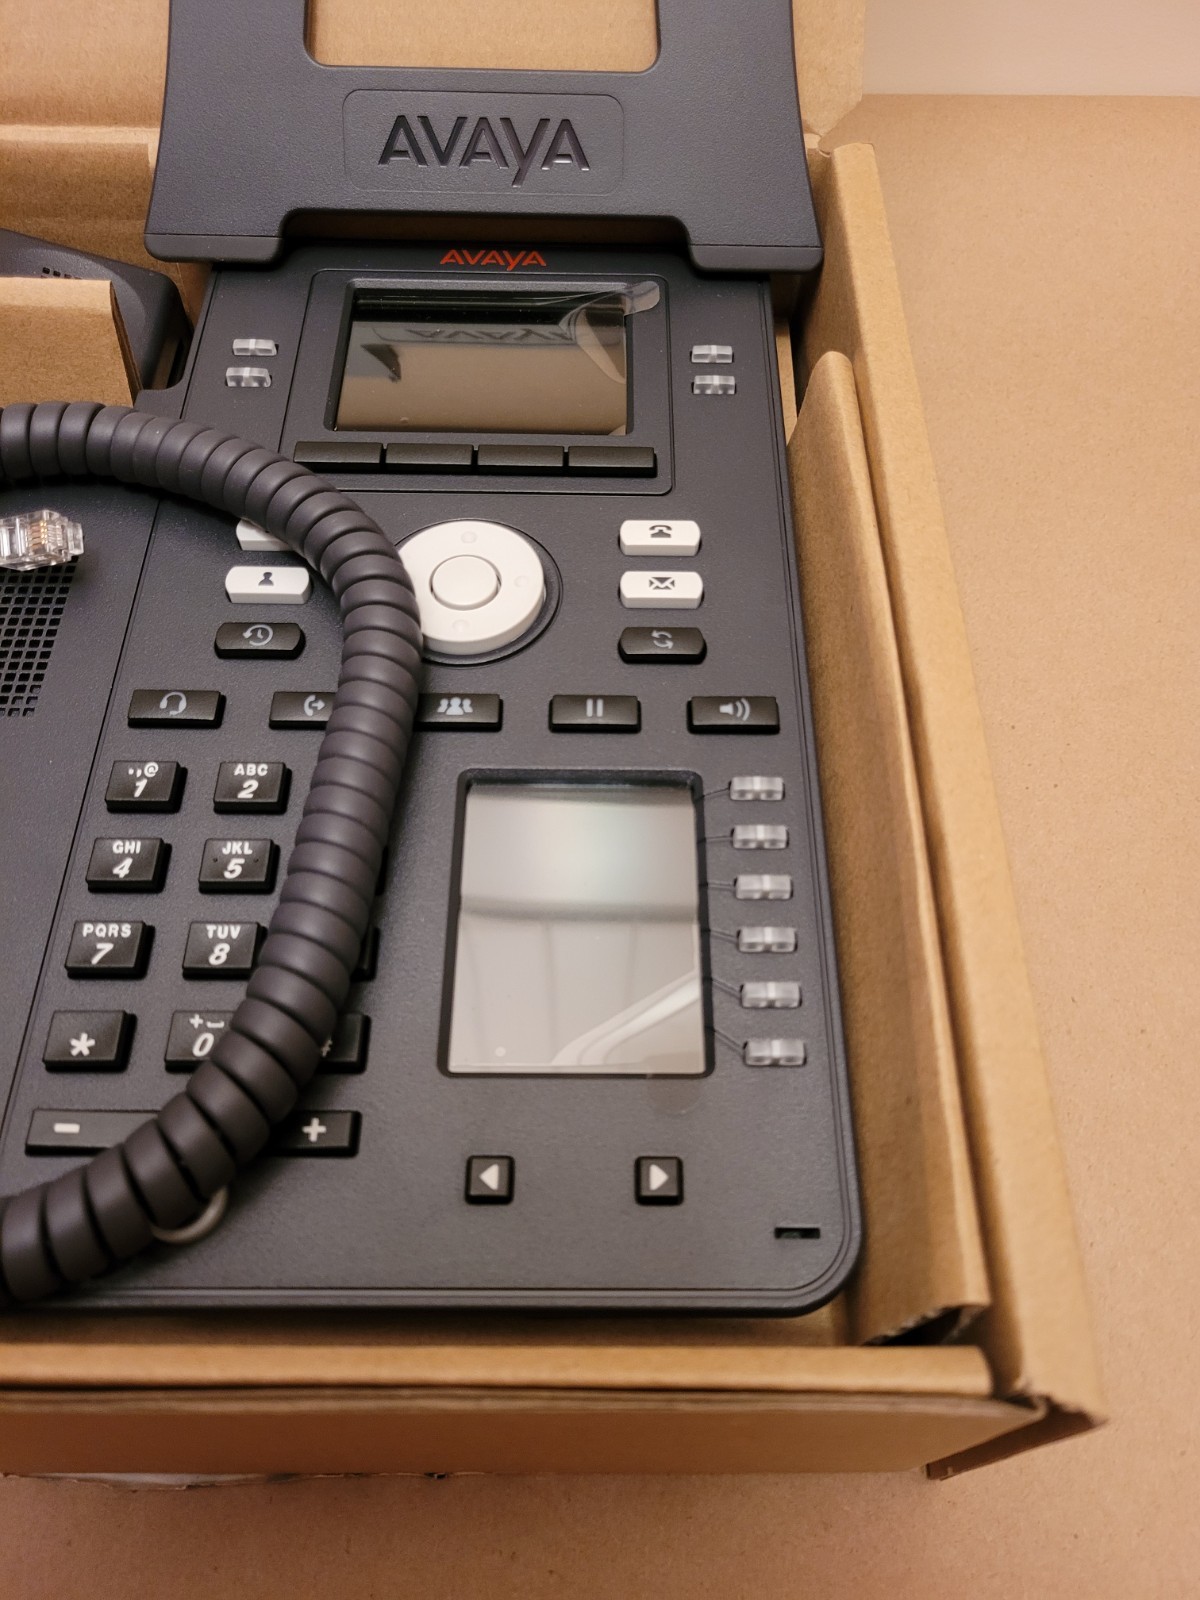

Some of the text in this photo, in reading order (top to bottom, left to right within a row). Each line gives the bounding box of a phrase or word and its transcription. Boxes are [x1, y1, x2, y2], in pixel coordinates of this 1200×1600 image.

[378, 115, 591, 187] AVAYA
[440, 249, 547, 271] AVAYA
[233, 763, 269, 777] ABC
[134, 778, 149, 798] 1
[237, 779, 259, 799] 2
[112, 840, 142, 854] GHI
[221, 841, 254, 855] JKL
[112, 857, 133, 879] 4
[223, 857, 246, 879] 5
[82, 923, 132, 938] PQRS
[206, 924, 241, 940] TUV
[91, 942, 114, 965] 7
[208, 942, 231, 966] 8
[192, 1032, 215, 1058] 0
